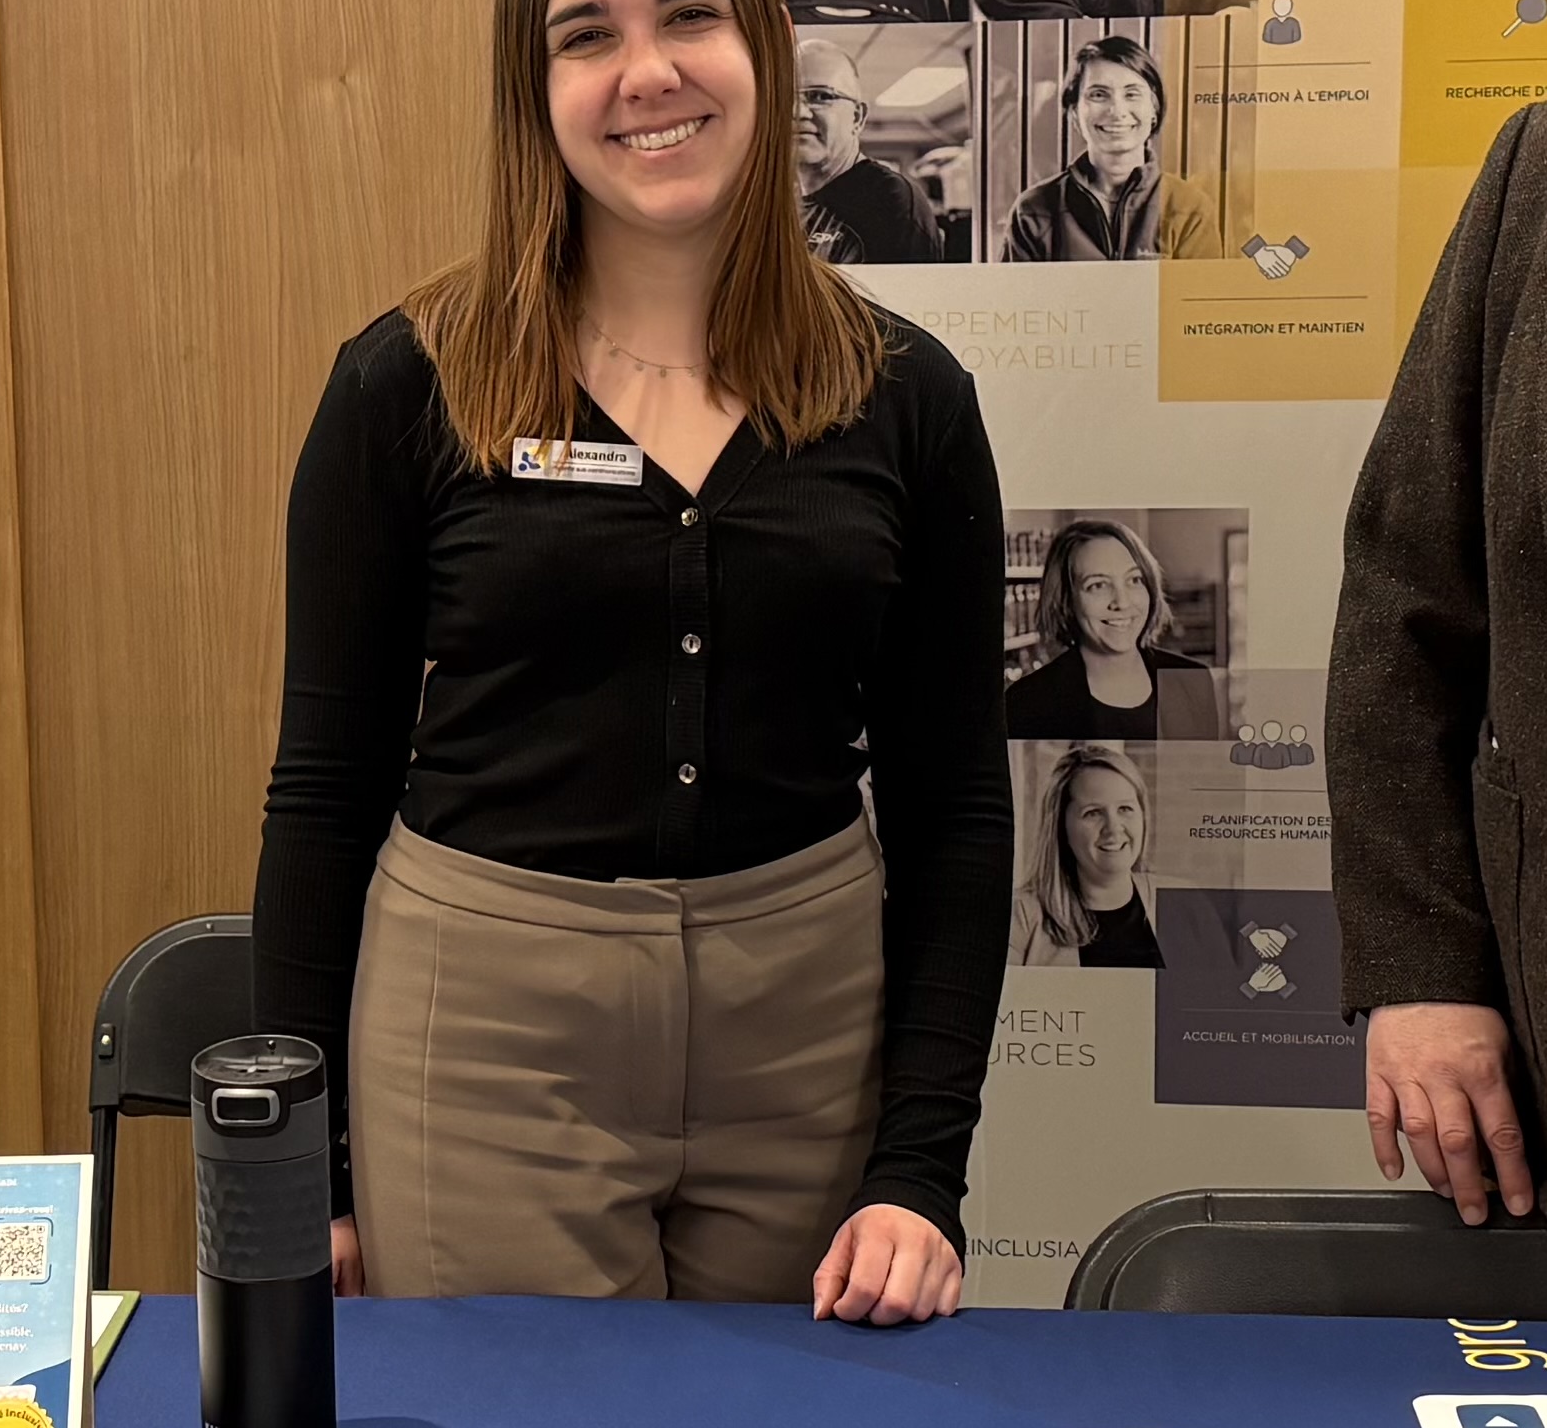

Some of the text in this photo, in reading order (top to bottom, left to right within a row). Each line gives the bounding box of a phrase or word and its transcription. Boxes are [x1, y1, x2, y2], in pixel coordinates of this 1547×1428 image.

[1193, 86, 1370, 105] PRÉPARATION À L'EMPLOI
[1445, 86, 1531, 99] RECHERCHE
[906, 309, 1090, 335] PPEMENT
[1183, 321, 1366, 337] INTÉGRATION ET MAINTIEN
[961, 338, 1143, 370] OYABILITÉ
[1202, 814, 1304, 826] PLANIFICATION
[1189, 827, 1332, 840] RESSOURCES HUMAIN
[996, 1009, 1086, 1033] MENT
[1182, 1031, 1356, 1046] ACCUEIL ET MOBILISATION
[987, 1042, 1096, 1067] URCES
[965, 1237, 1081, 1259] INCLUSIA
